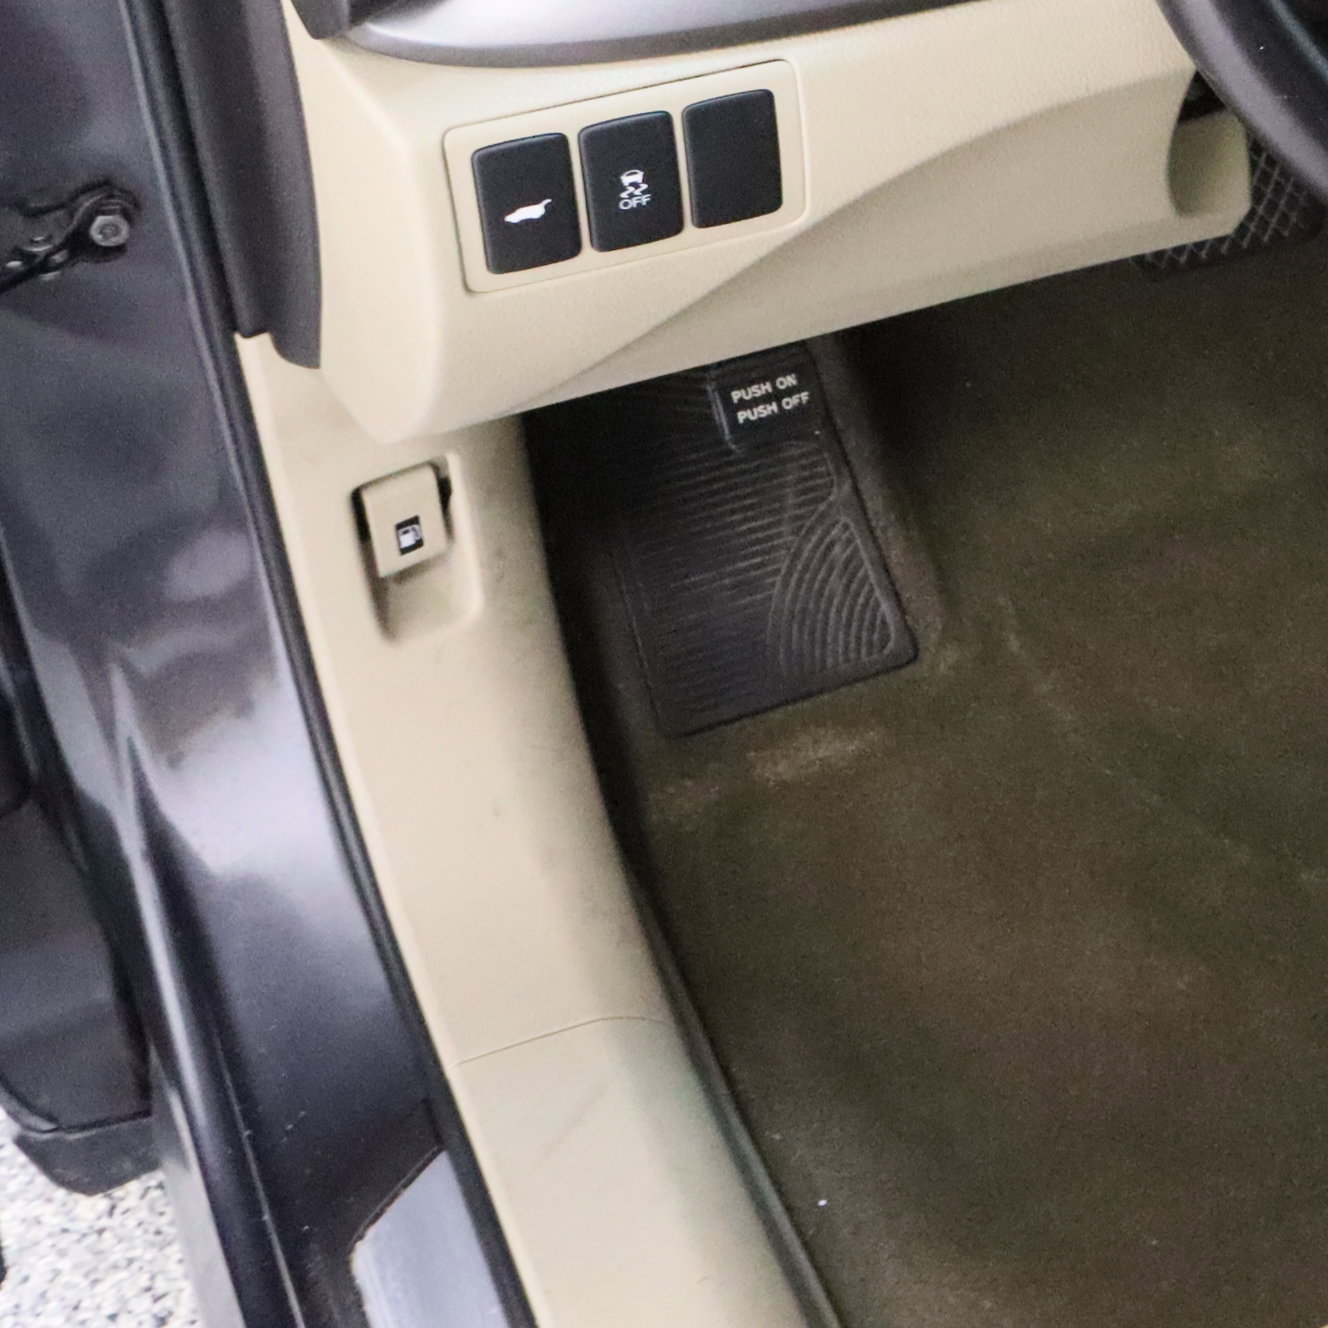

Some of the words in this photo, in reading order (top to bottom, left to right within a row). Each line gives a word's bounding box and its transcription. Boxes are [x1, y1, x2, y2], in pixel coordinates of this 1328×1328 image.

[619, 193, 651, 211] OFF
[731, 381, 772, 404] PUSH
[776, 373, 797, 391] ON
[737, 401, 778, 424] PUSH
[781, 391, 810, 411] OFF
